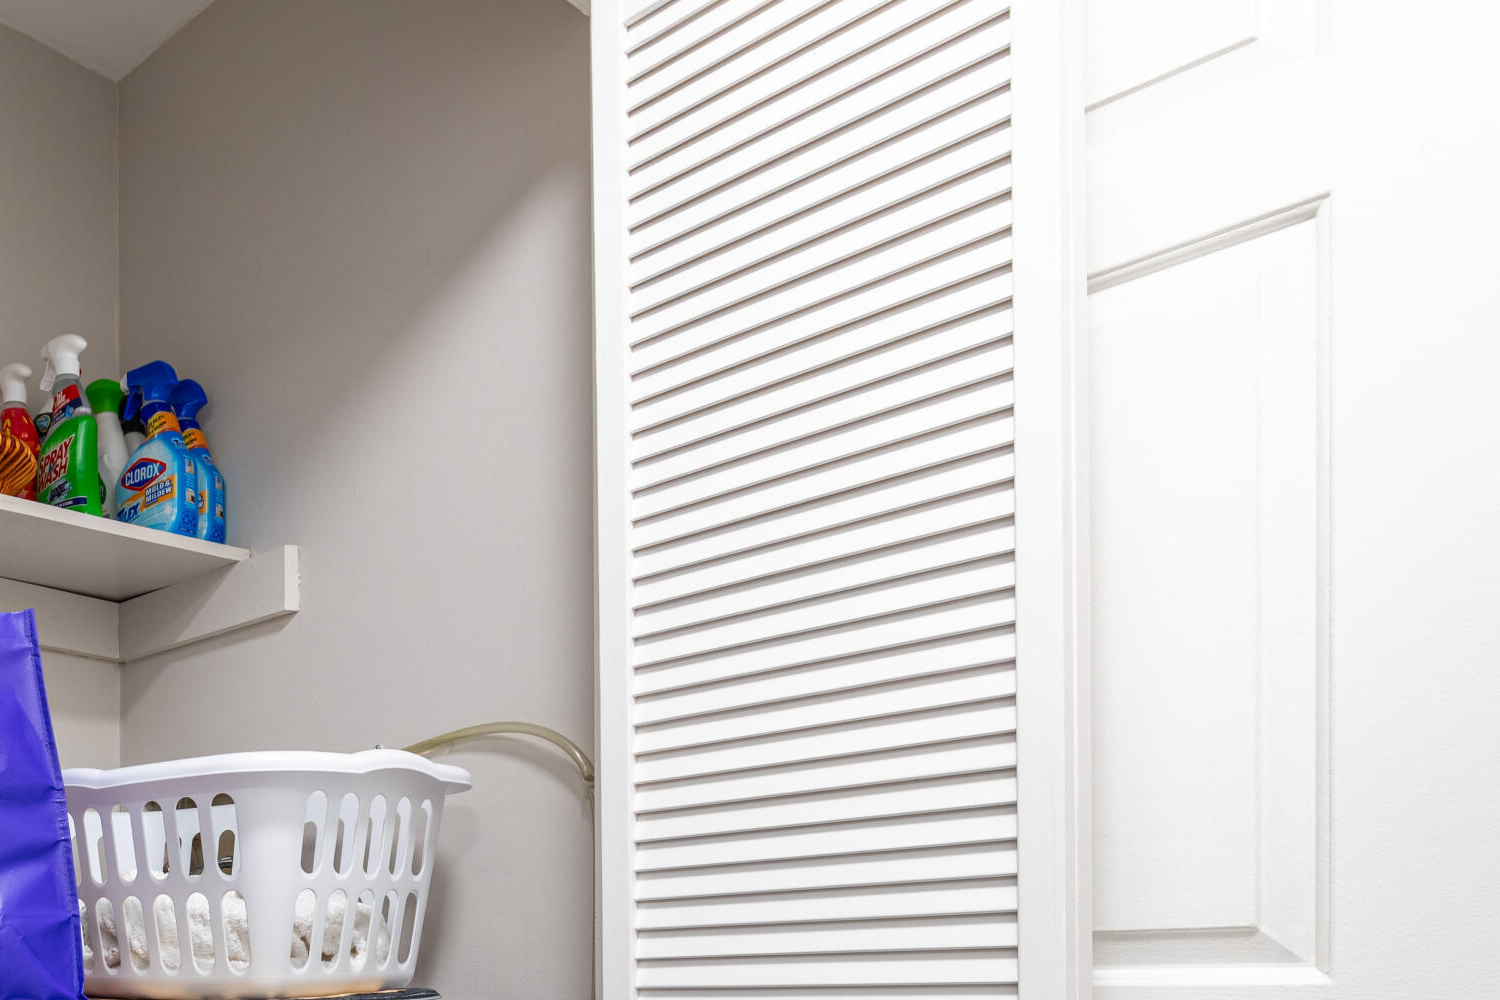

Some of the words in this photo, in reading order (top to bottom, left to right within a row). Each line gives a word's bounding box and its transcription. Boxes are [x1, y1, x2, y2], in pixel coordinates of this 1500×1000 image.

[40, 434, 74, 470] SPRAY
[124, 462, 160, 486] CLOROX
[145, 480, 164, 496] MOLD
[145, 486, 172, 503] MILDEW
